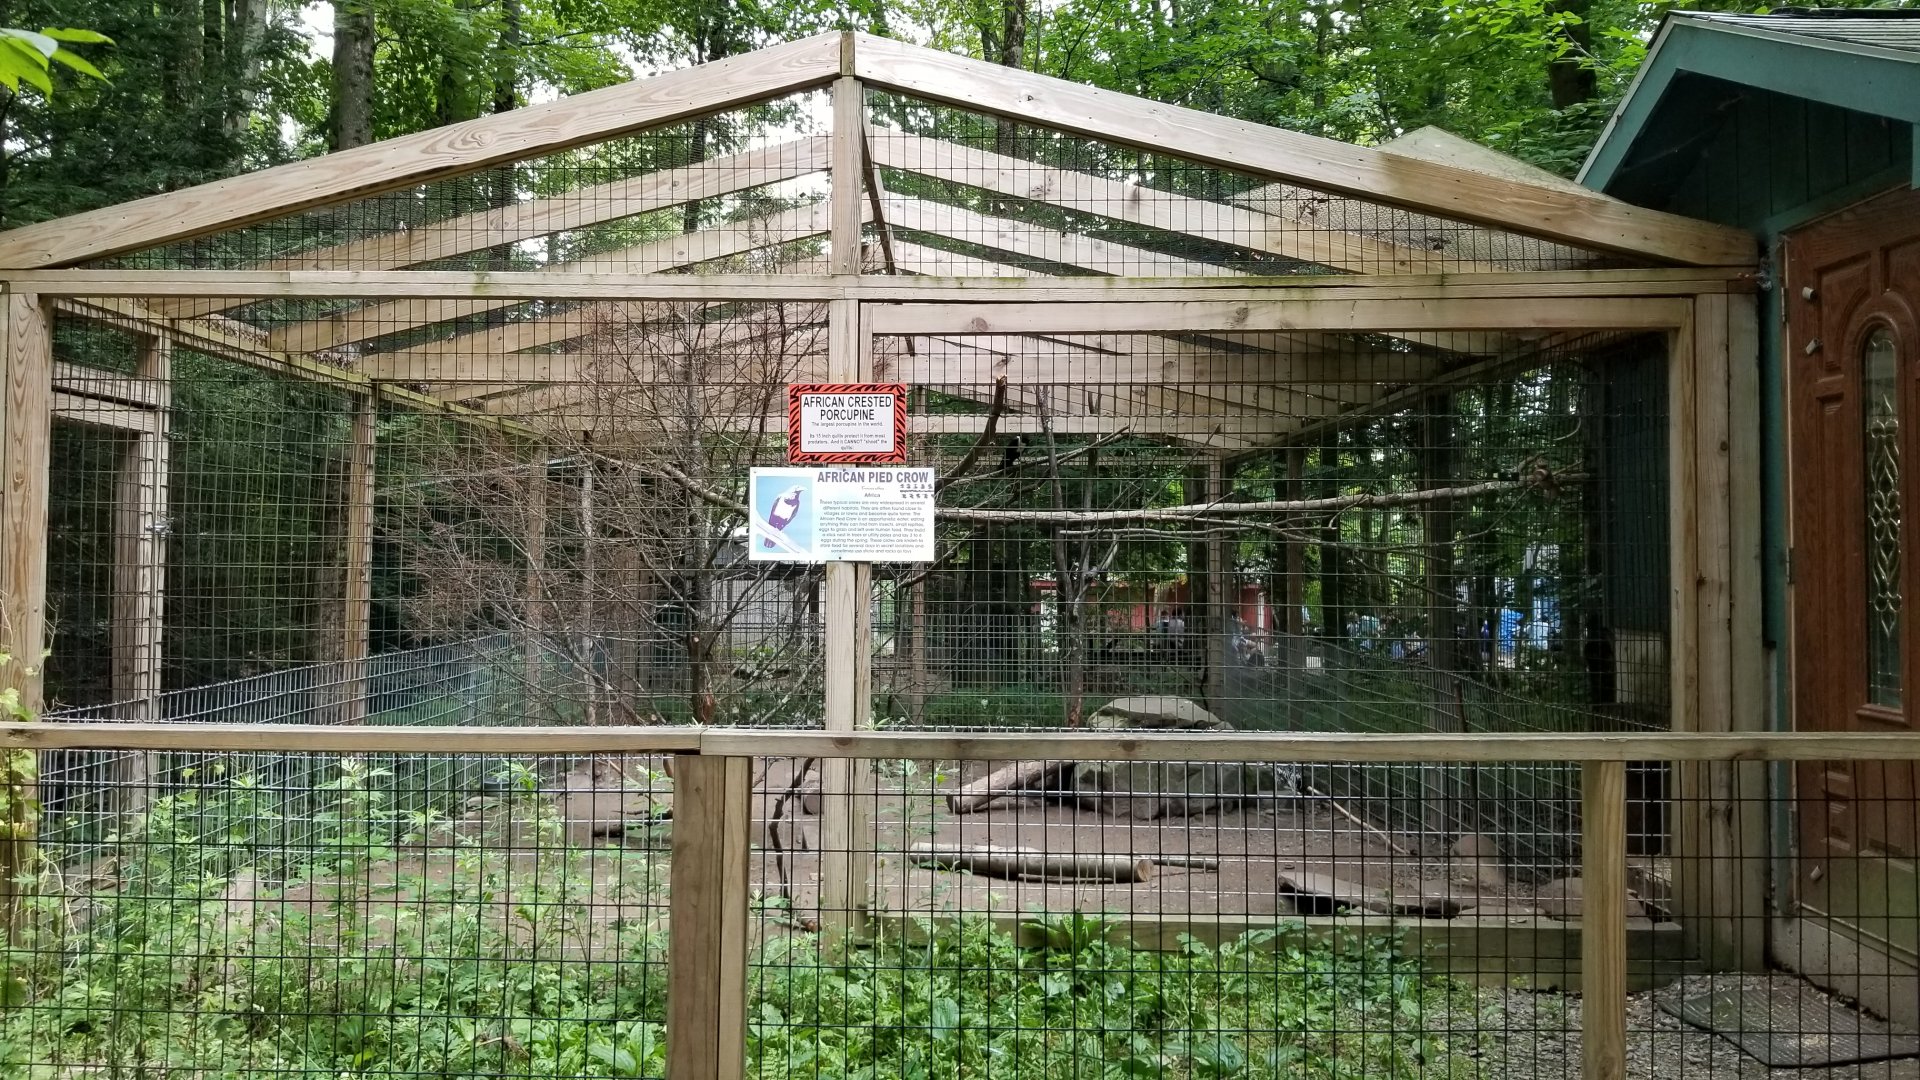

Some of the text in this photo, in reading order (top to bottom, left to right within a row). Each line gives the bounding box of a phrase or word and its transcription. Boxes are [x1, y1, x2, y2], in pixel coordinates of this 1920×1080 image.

[803, 396, 892, 408] AFRICAN CRESTED
[820, 409, 875, 421] PORCUPINE
[817, 471, 928, 483] AFRICAN PIED CROW
